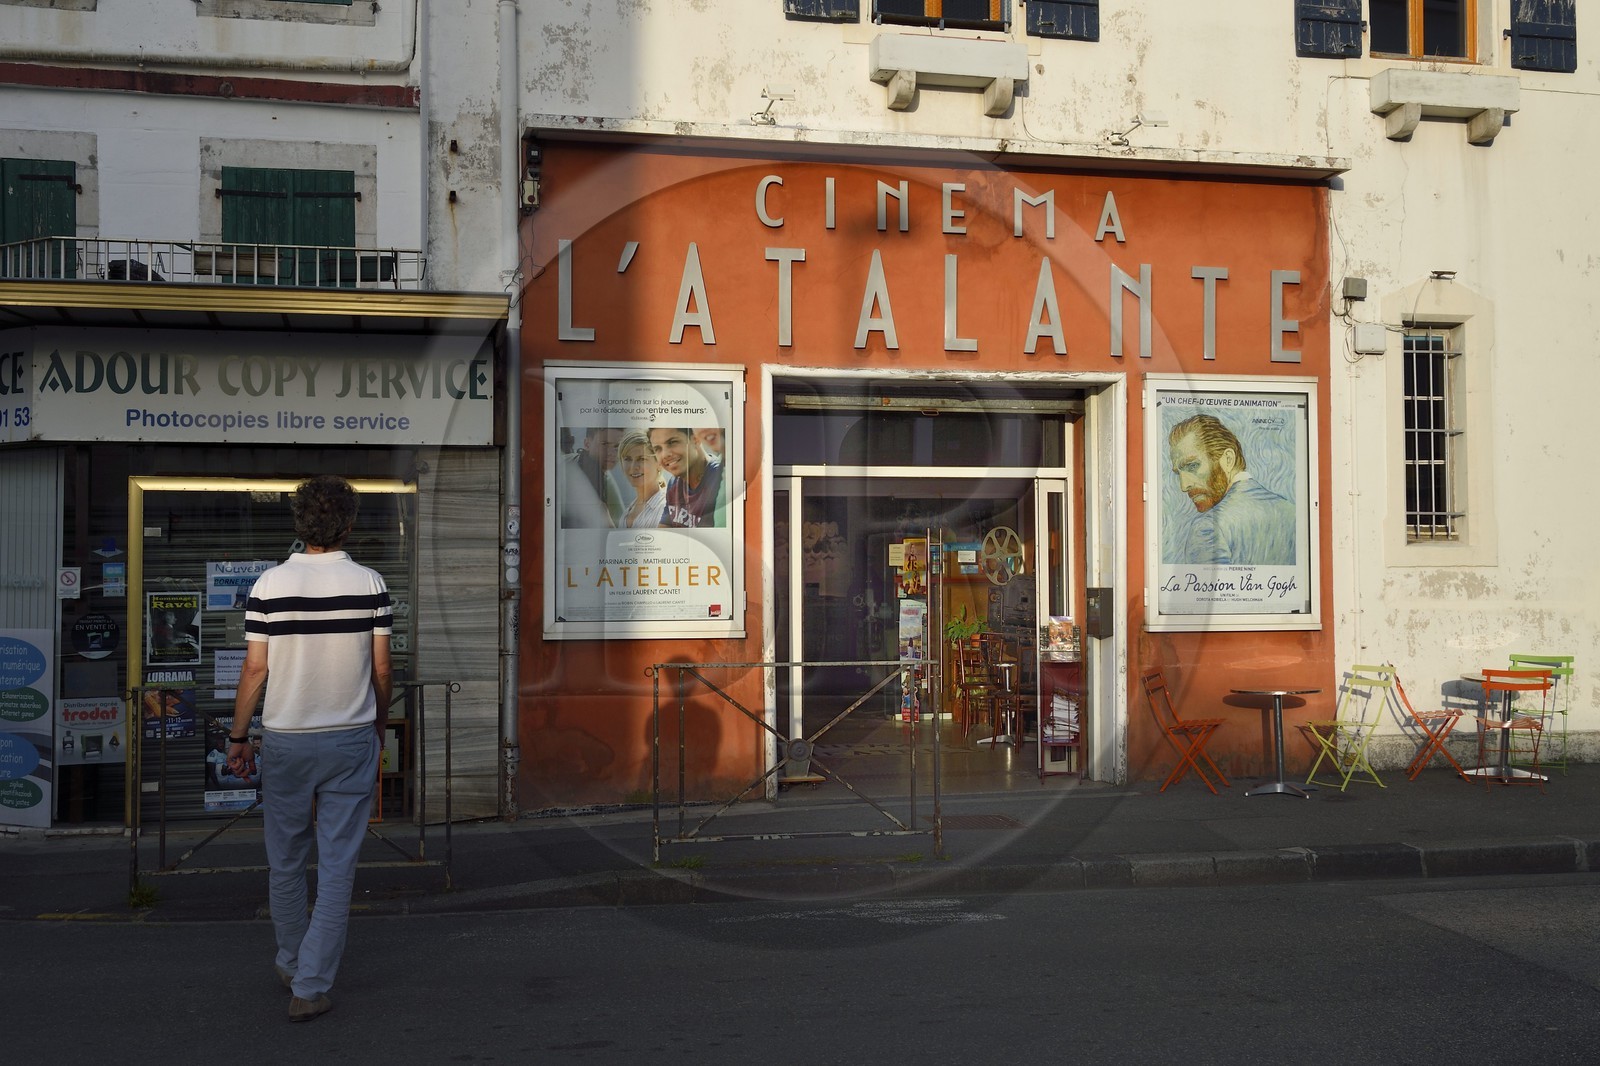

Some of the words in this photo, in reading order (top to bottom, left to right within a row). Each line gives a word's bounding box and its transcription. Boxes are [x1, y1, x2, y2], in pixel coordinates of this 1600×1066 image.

[756, 175, 1126, 242] CINEMA
[558, 238, 1301, 363] L'ATALANTE
[39, 349, 201, 396] ADOUR
[218, 354, 323, 398] COPY
[608, 398, 628, 406] grand
[660, 398, 689, 406] jeunesse
[14, 407, 30, 427] 53
[126, 409, 269, 432] Photocopies
[277, 411, 326, 429] libre
[333, 413, 411, 431] service
[215, 563, 268, 574] Nouveau
[567, 565, 721, 588] L'ATELIER
[1160, 576, 1180, 592] La
[1184, 573, 1236, 592] Passion
[1240, 573, 1263, 590] Van
[1267, 576, 1297, 598] Gogh
[3, 659, 40, 674] numérique
[147, 671, 192, 682] LURRAMA
[63, 707, 118, 721] trodat
